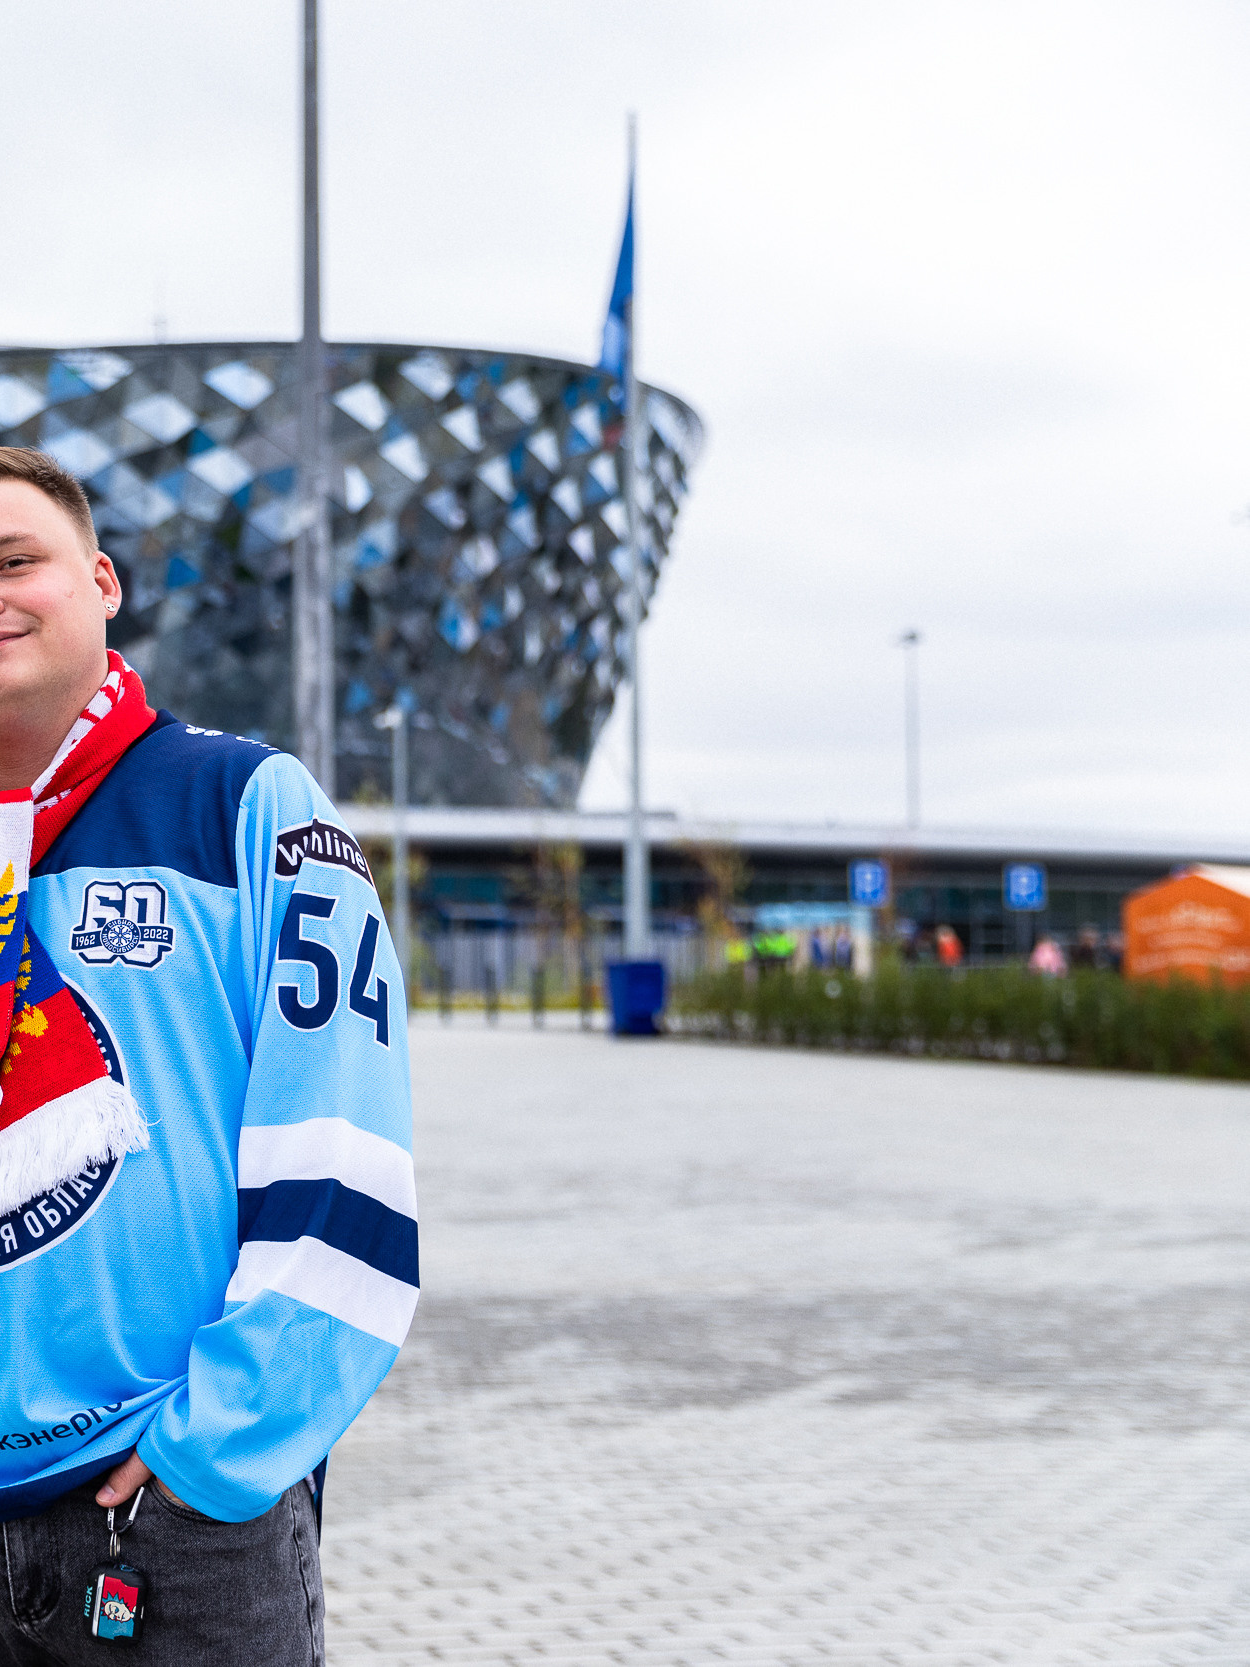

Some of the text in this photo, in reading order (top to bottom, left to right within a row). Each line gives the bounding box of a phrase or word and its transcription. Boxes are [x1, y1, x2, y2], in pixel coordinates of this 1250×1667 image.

[81, 880, 166, 968] 60
[143, 928, 169, 941] 2022
[75, 934, 96, 948] 1962
[275, 889, 390, 1050] 54
[83, 1585, 94, 1618] RICK
